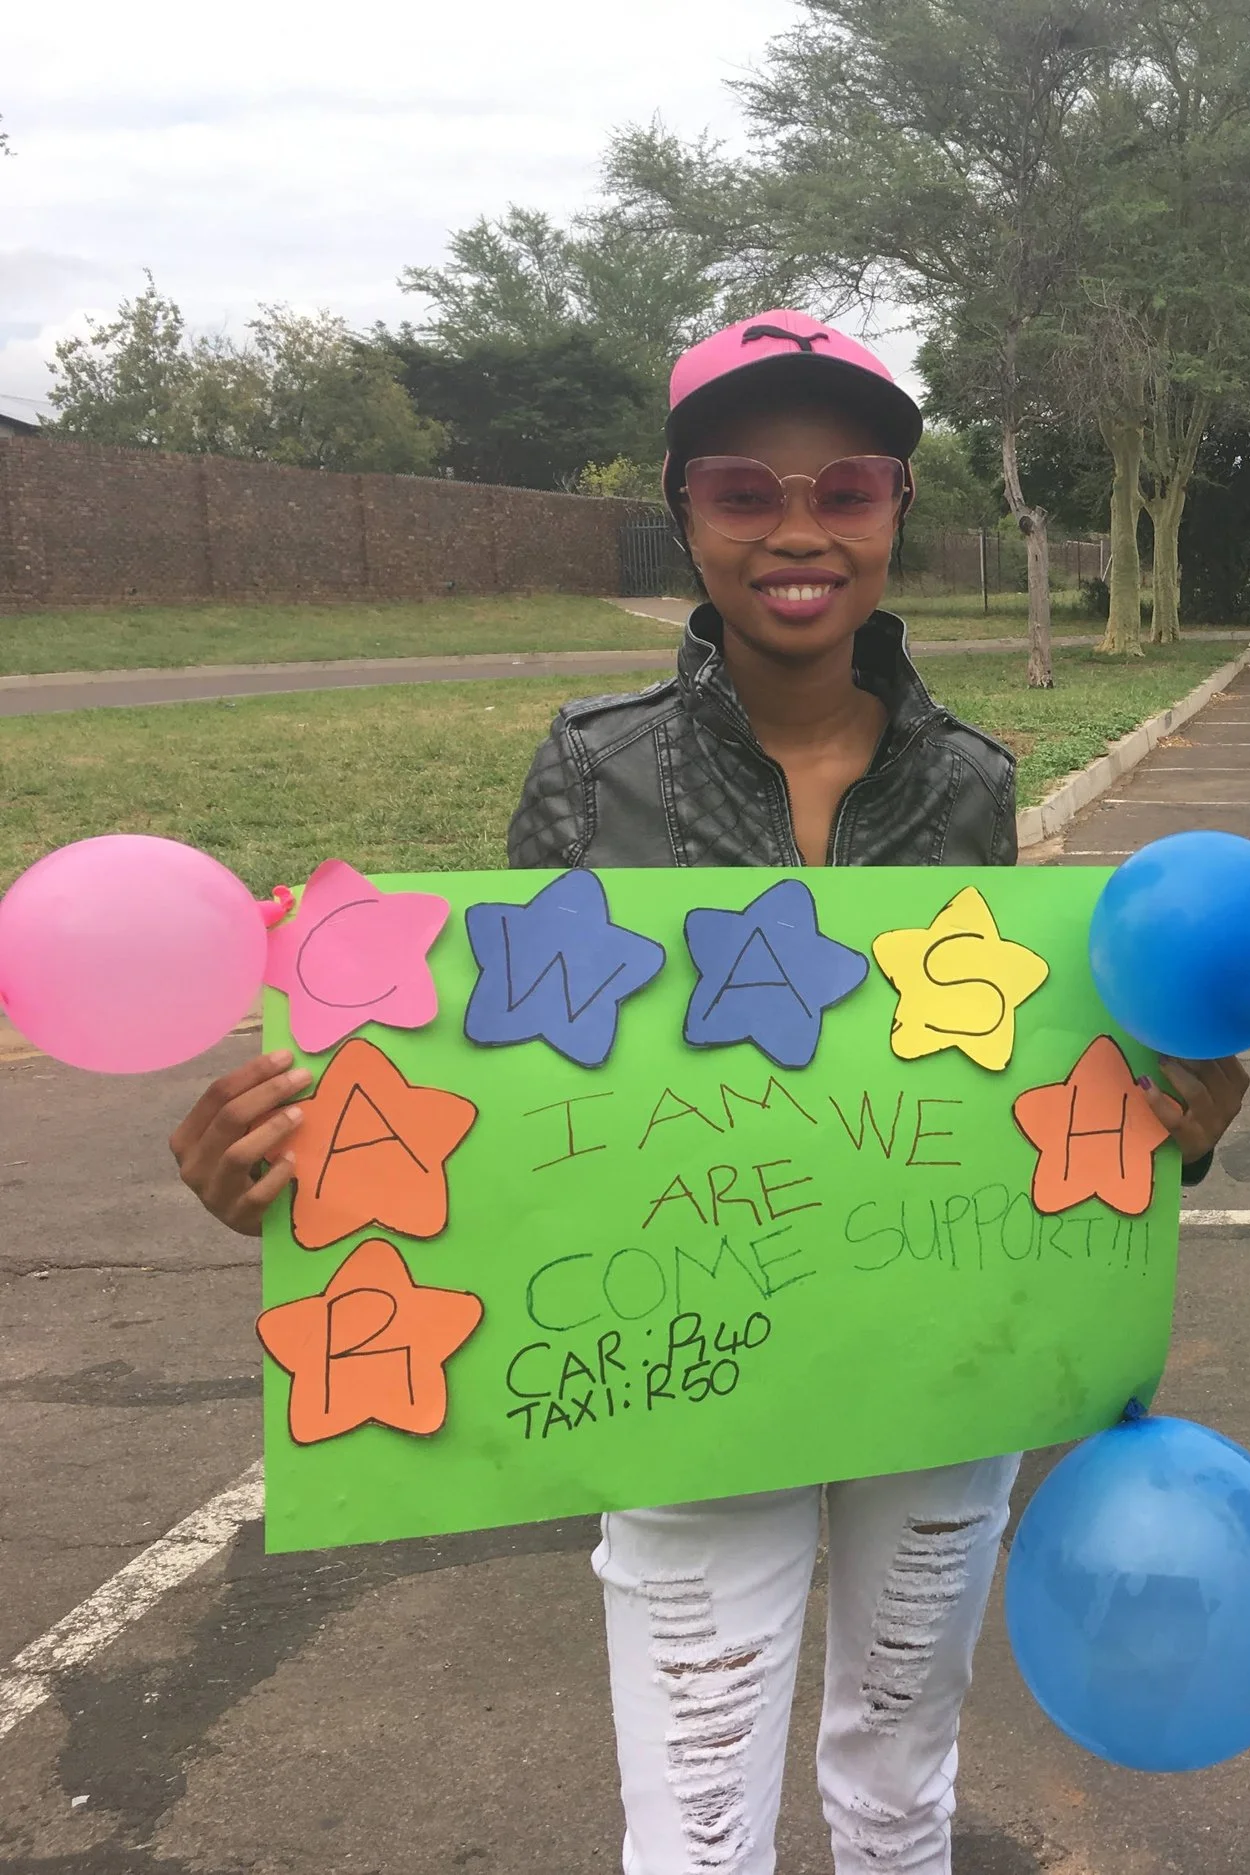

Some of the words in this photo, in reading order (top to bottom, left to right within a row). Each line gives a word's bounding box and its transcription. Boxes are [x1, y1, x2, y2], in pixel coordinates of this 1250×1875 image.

[522, 1091, 614, 1172] I
[828, 1090, 963, 1166] WE
[641, 1158, 822, 1230] ARE
[525, 1225, 817, 1331] COME
